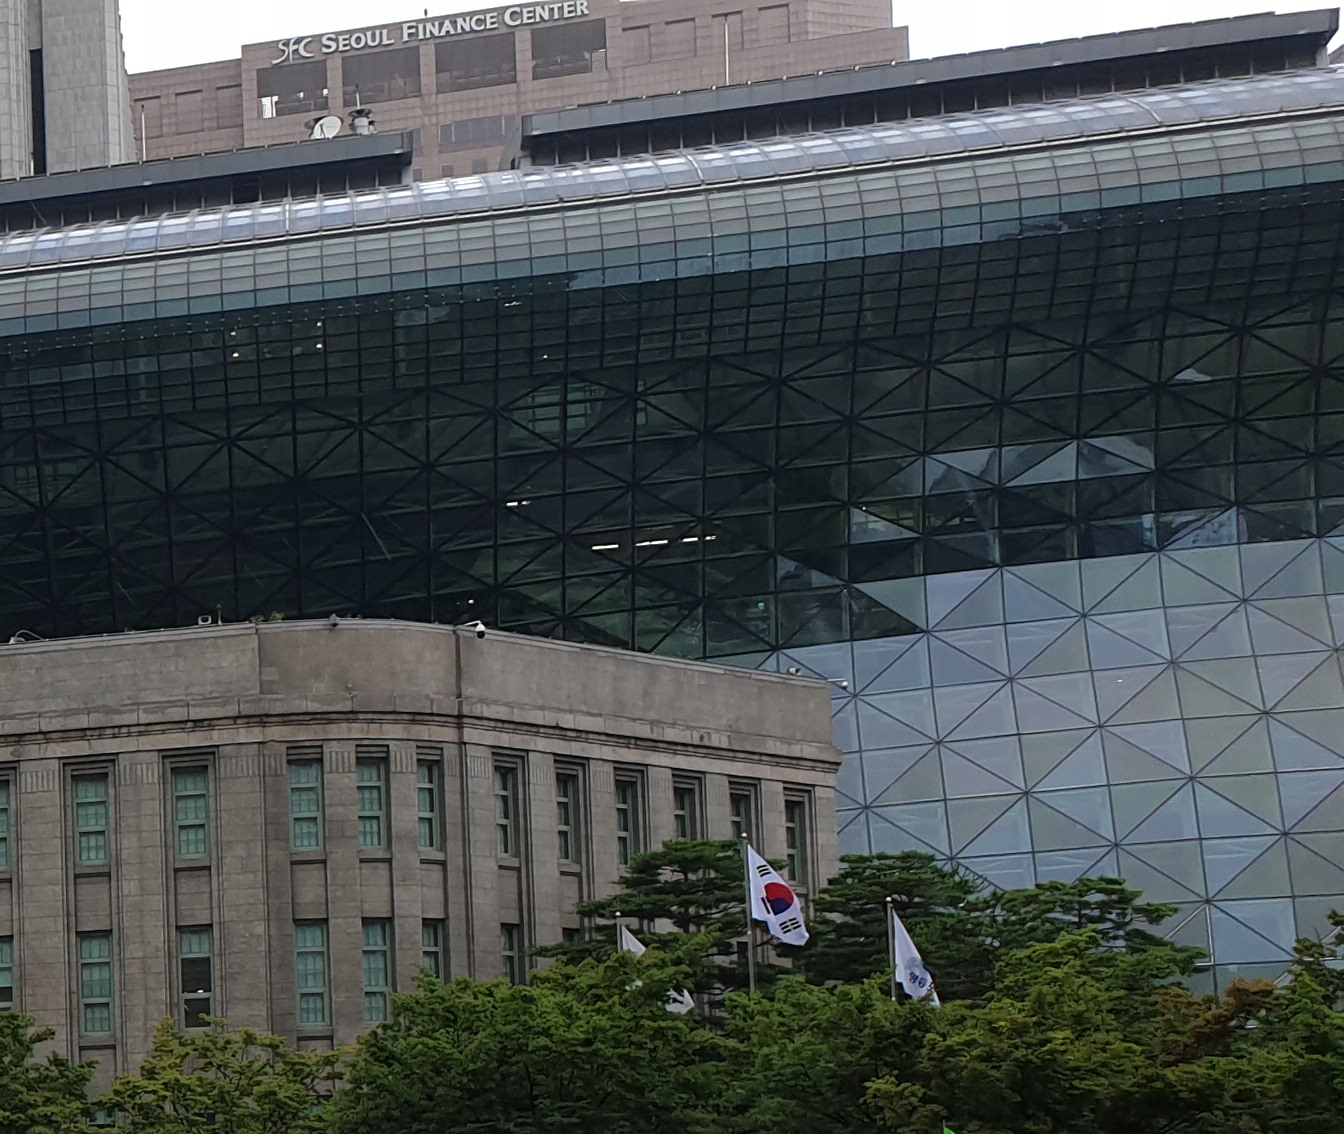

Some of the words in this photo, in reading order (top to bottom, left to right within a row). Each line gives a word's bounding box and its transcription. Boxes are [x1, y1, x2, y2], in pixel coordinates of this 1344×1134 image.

[272, 37, 315, 65] SFC
[321, 28, 395, 54] SEOUL
[402, 11, 499, 43] FINANCE
[503, 0, 591, 27] CENTER
